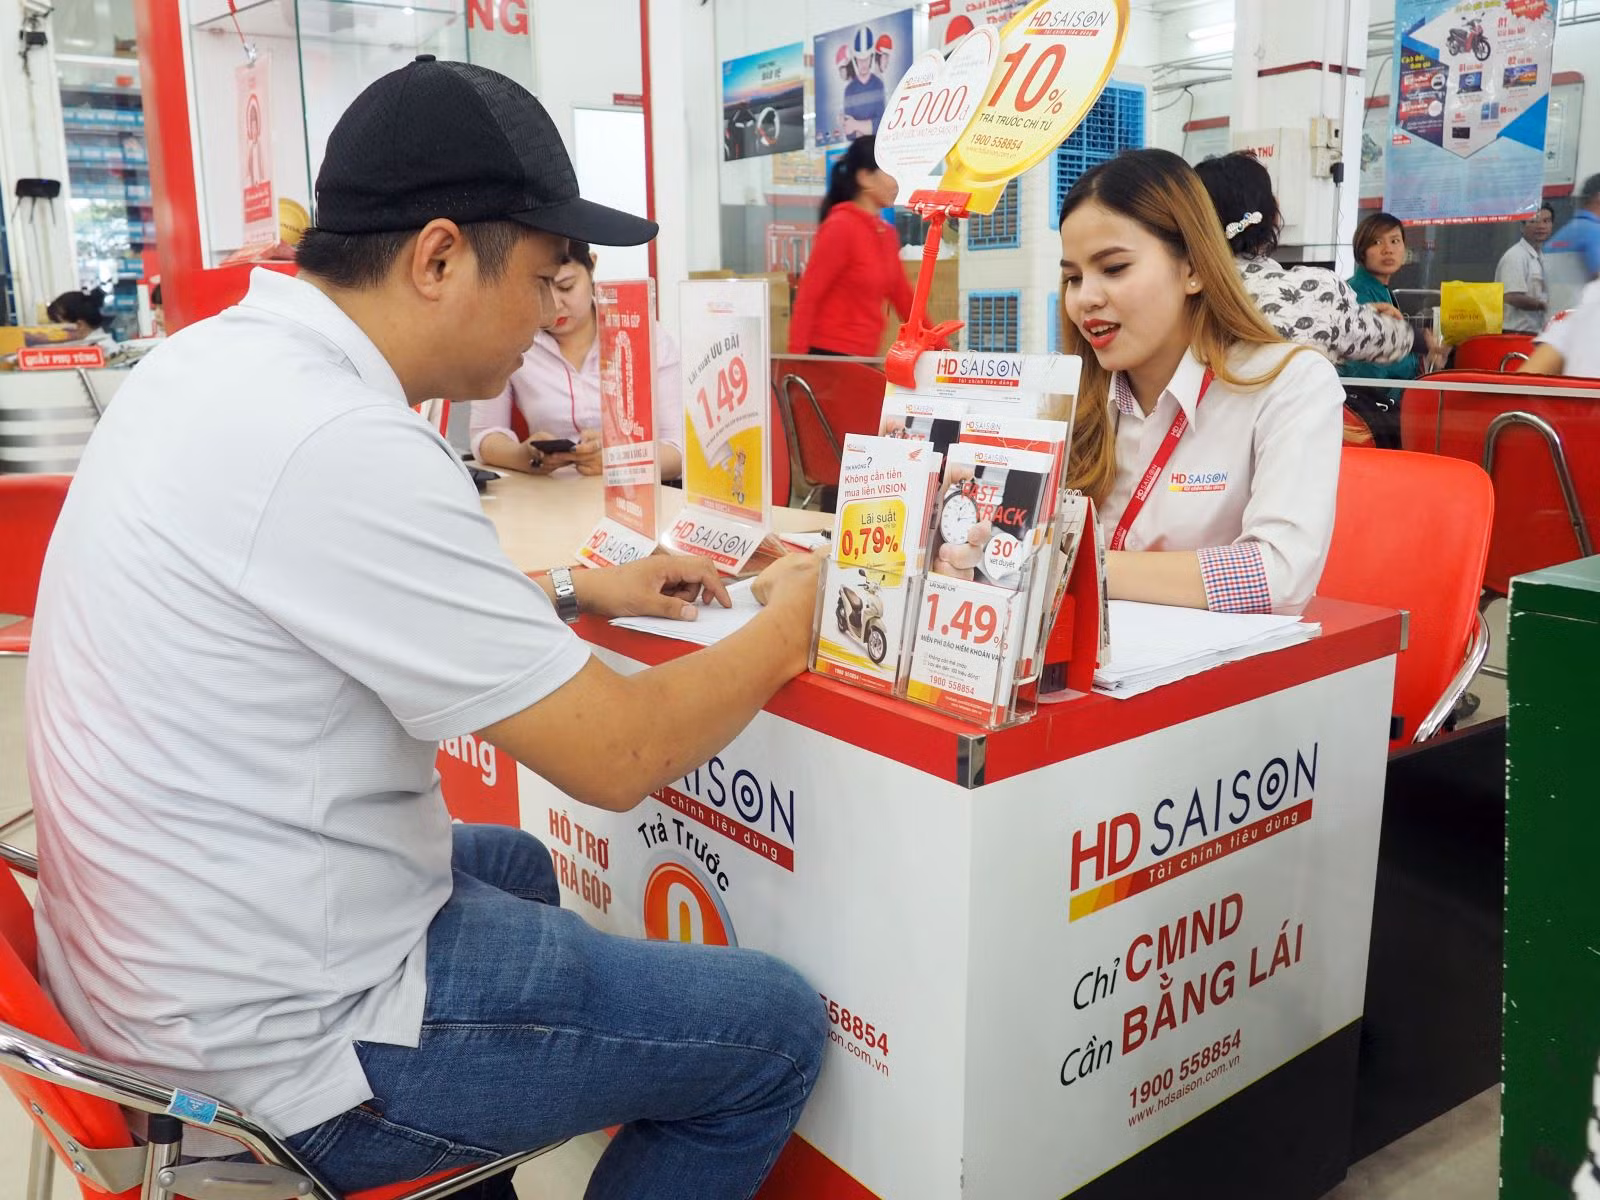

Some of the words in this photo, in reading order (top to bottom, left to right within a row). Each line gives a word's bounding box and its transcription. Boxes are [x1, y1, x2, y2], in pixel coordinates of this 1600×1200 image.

[971, 134, 991, 146] 1900
[937, 358, 958, 375] HD
[960, 358, 1022, 377] SAISON
[845, 489, 860, 498] mua
[878, 483, 907, 494] VISION
[961, 483, 1000, 502] FAST
[1171, 473, 1186, 485] HD
[1187, 471, 1228, 485] SAISON
[861, 511, 875, 526] Lãi
[876, 508, 897, 523] suất
[975, 504, 1028, 527] TRACK
[590, 528, 607, 550] HD
[674, 520, 695, 539] HD
[690, 526, 754, 557] SAISON
[841, 526, 898, 561] 0,79%
[930, 675, 946, 686] 1900
[948, 680, 975, 695] 558854
[684, 756, 795, 845] ISON
[1070, 812, 1141, 891] HD
[1150, 742, 1318, 856] SAISON
[671, 796, 704, 819] chính
[710, 813, 736, 836] tiêu
[744, 831, 778, 861] dùng
[1149, 861, 1172, 883] Tài
[1180, 842, 1222, 870] chính
[1230, 827, 1258, 849] tiêu
[1265, 810, 1299, 835] dùng
[638, 812, 668, 849] Trả
[672, 818, 729, 892] Trước
[582, 868, 612, 915] GÓP
[1073, 957, 1121, 1010] Chỉ
[1125, 893, 1244, 983] CMND
[1060, 1034, 1113, 1086] Cần
[1121, 960, 1235, 1056] BẰNG
[1249, 918, 1304, 988] LÁI
[1129, 1066, 1173, 1109] 1900
[1179, 1028, 1241, 1084] 558854
[1128, 1053, 1240, 1127] www.hdsaison.com.vn
